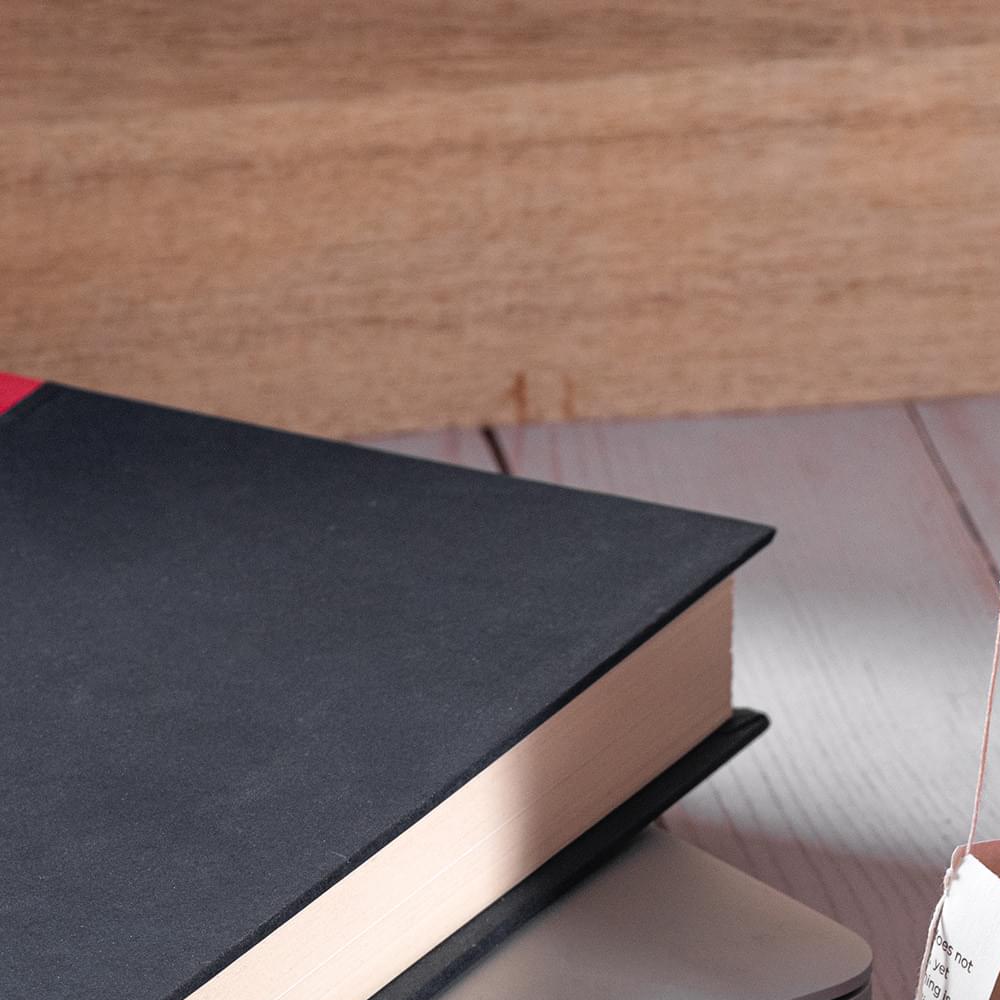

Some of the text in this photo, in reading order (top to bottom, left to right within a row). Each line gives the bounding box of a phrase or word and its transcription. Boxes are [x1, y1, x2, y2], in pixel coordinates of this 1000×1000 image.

[935, 932, 974, 974] oes not
[932, 959, 950, 980] yet
